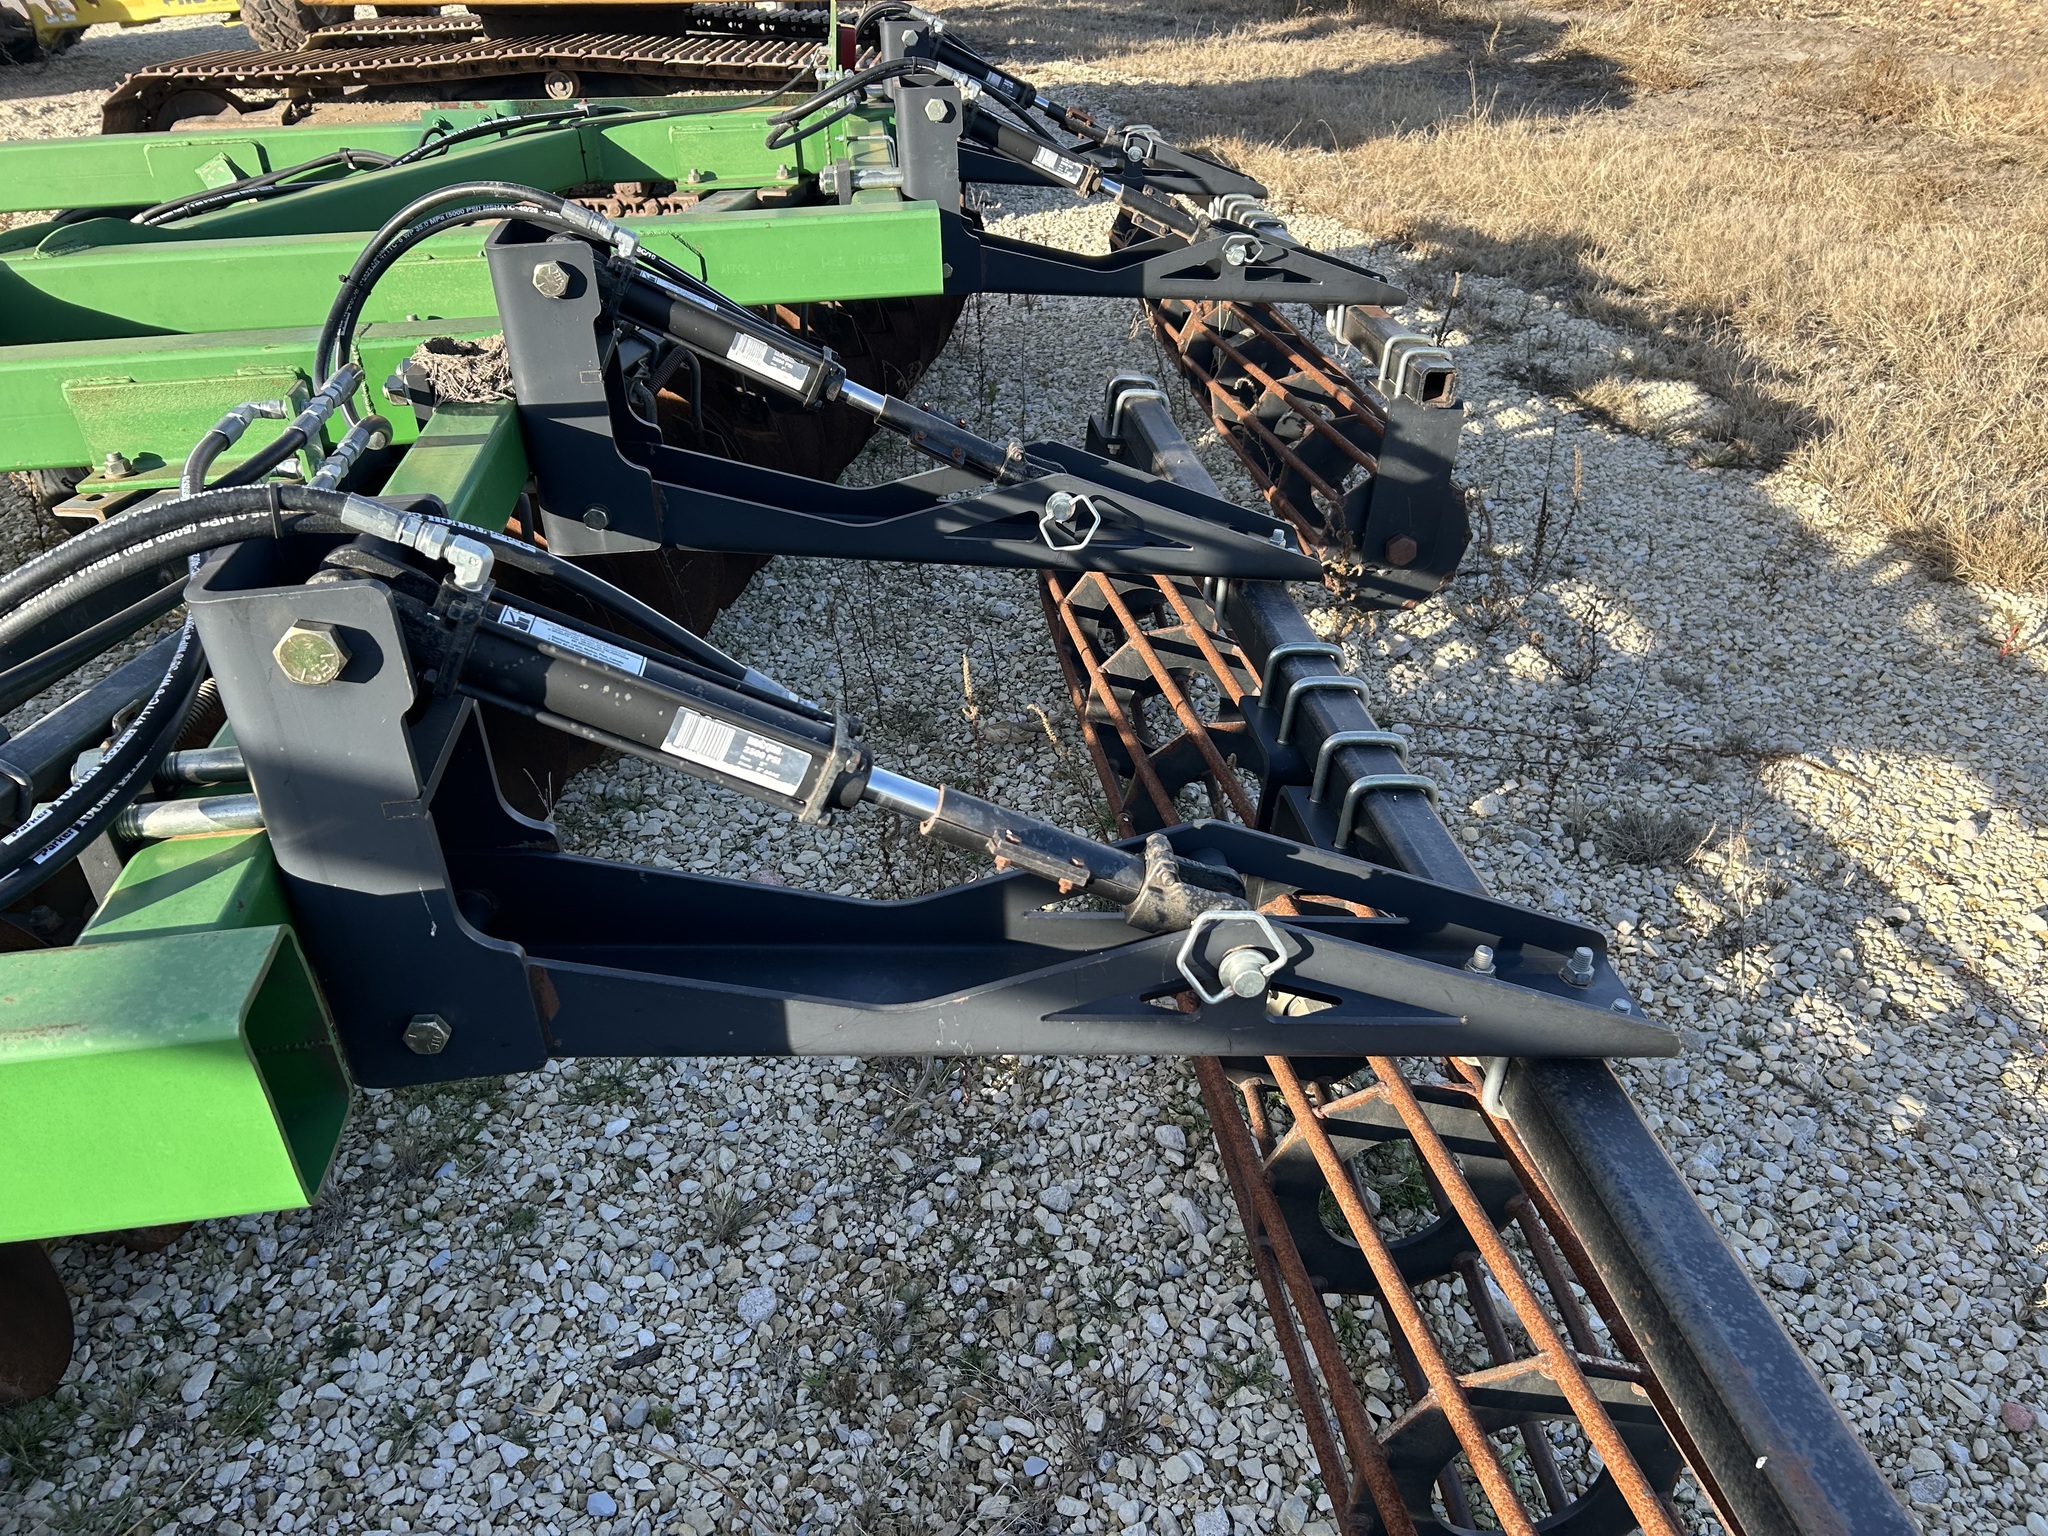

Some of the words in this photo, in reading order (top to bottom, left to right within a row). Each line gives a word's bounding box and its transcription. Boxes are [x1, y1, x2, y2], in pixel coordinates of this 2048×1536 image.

[429, 215, 445, 227] MPa
[445, 208, 466, 219] (5000
[155, 523, 197, 544] (5000
[123, 538, 154, 557] PSI)
[77, 552, 121, 578] MSHA
[159, 673, 175, 690] WP
[765, 753, 781, 765] PSI
[41, 827, 76, 857] Parker
